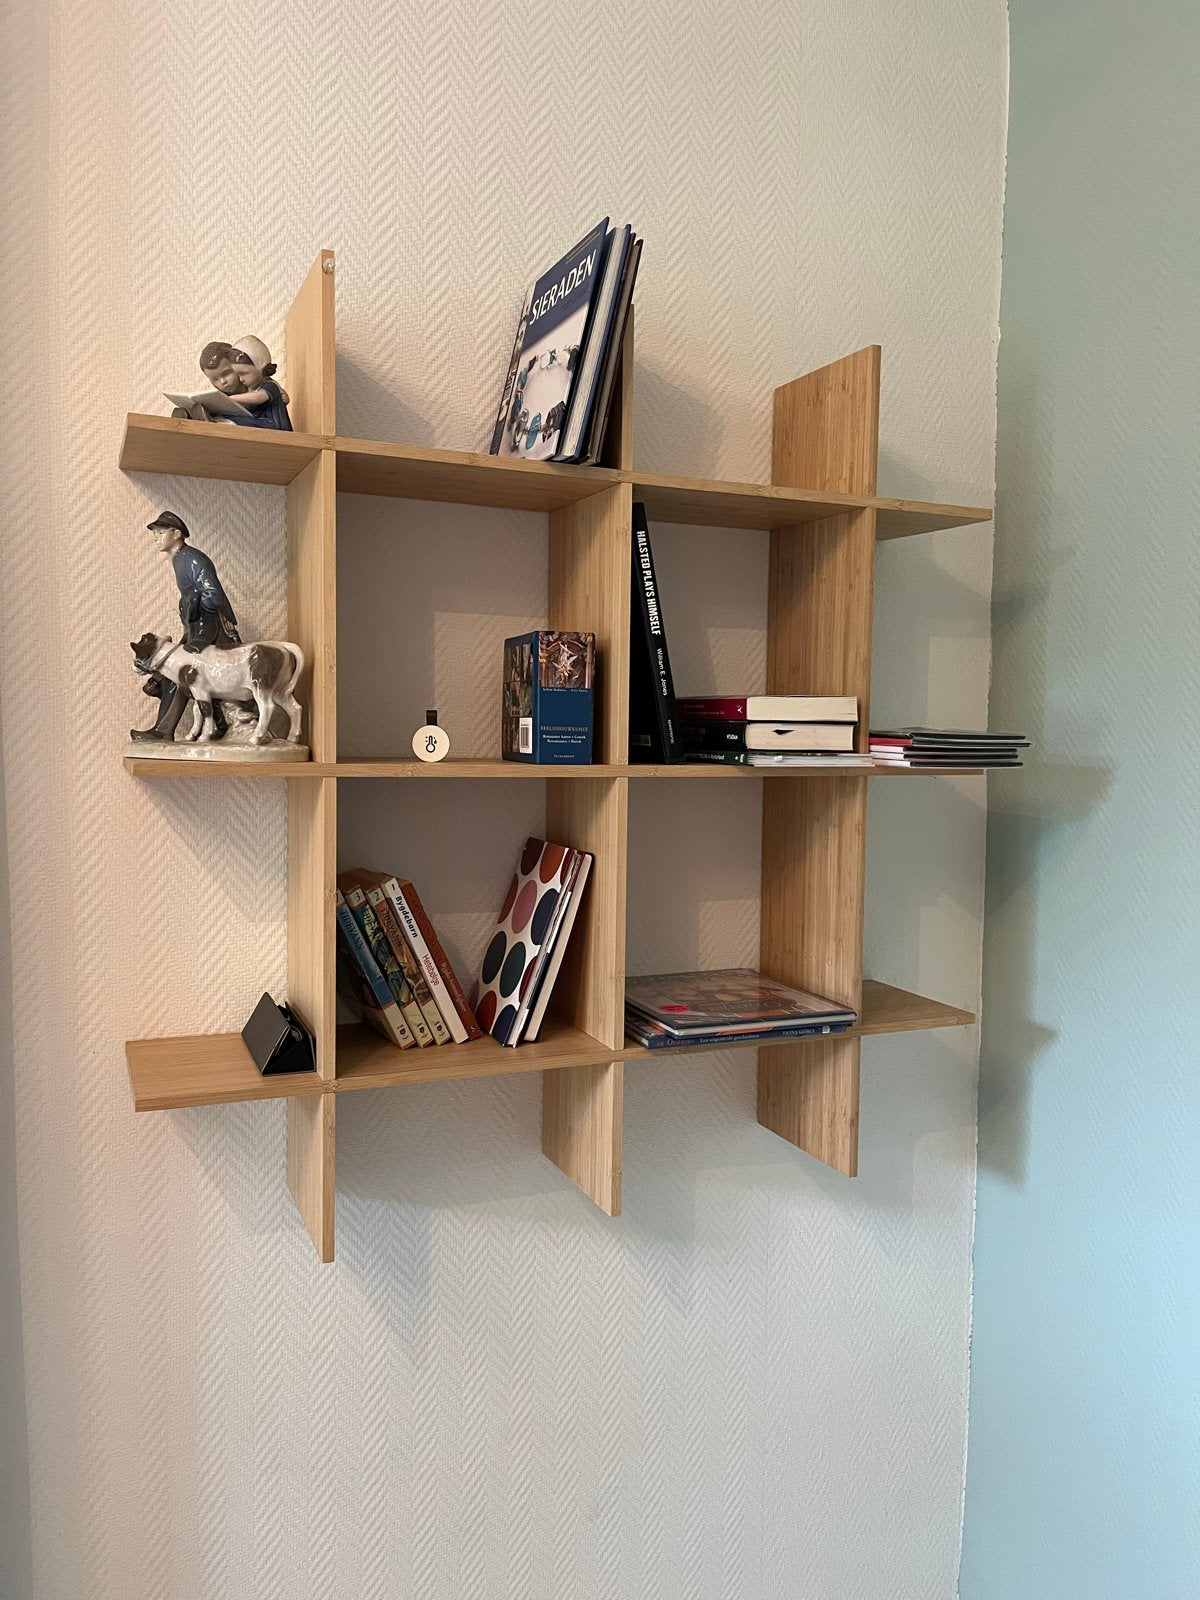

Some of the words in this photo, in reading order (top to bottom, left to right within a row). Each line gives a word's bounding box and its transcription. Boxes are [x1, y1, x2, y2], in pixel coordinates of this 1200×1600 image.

[529, 249, 597, 325] SIERADEN
[636, 530, 651, 569] HALSTED
[642, 570, 656, 598] PLAYS
[646, 598, 662, 636] HIMSELF
[656, 648, 665, 670] William
[341, 908, 365, 950] TIDEVANN
[353, 892, 361, 902] 3
[362, 906, 384, 945] TIDEVAN
[373, 891, 380, 902] 2
[381, 907, 402, 947] TIDEVANN
[395, 895, 418, 938] Bygdebarn
